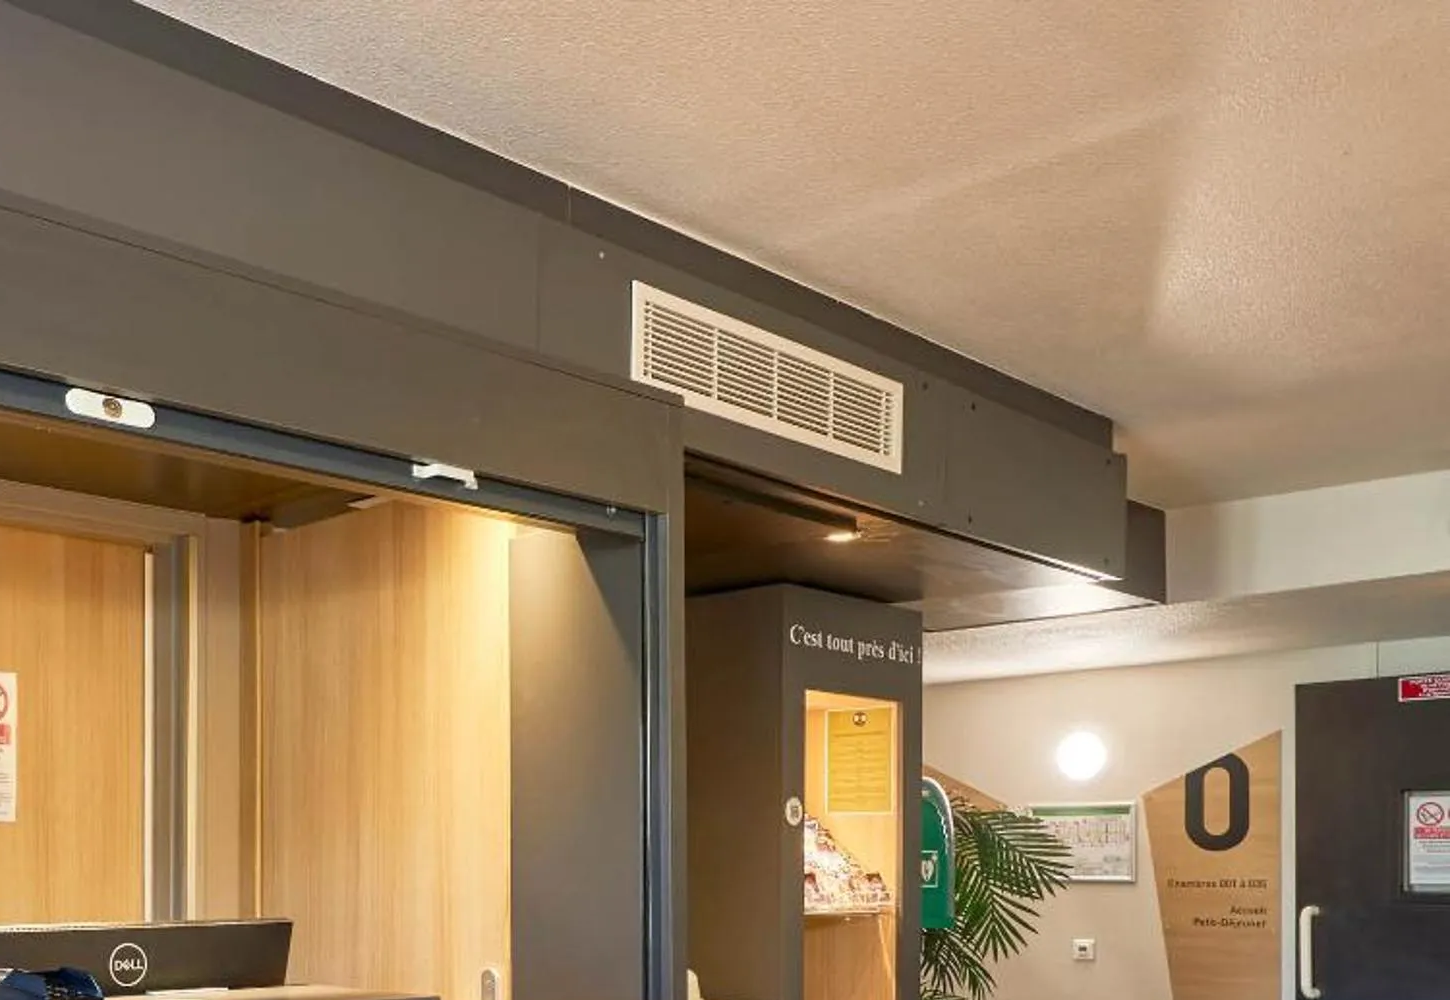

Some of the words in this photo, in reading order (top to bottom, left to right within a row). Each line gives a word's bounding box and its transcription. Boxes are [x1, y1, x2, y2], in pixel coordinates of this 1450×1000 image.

[789, 623, 822, 649] C'est
[826, 633, 854, 654] tout
[857, 639, 885, 661] près
[888, 640, 914, 665] d'ici
[114, 958, 144, 972] DELL
